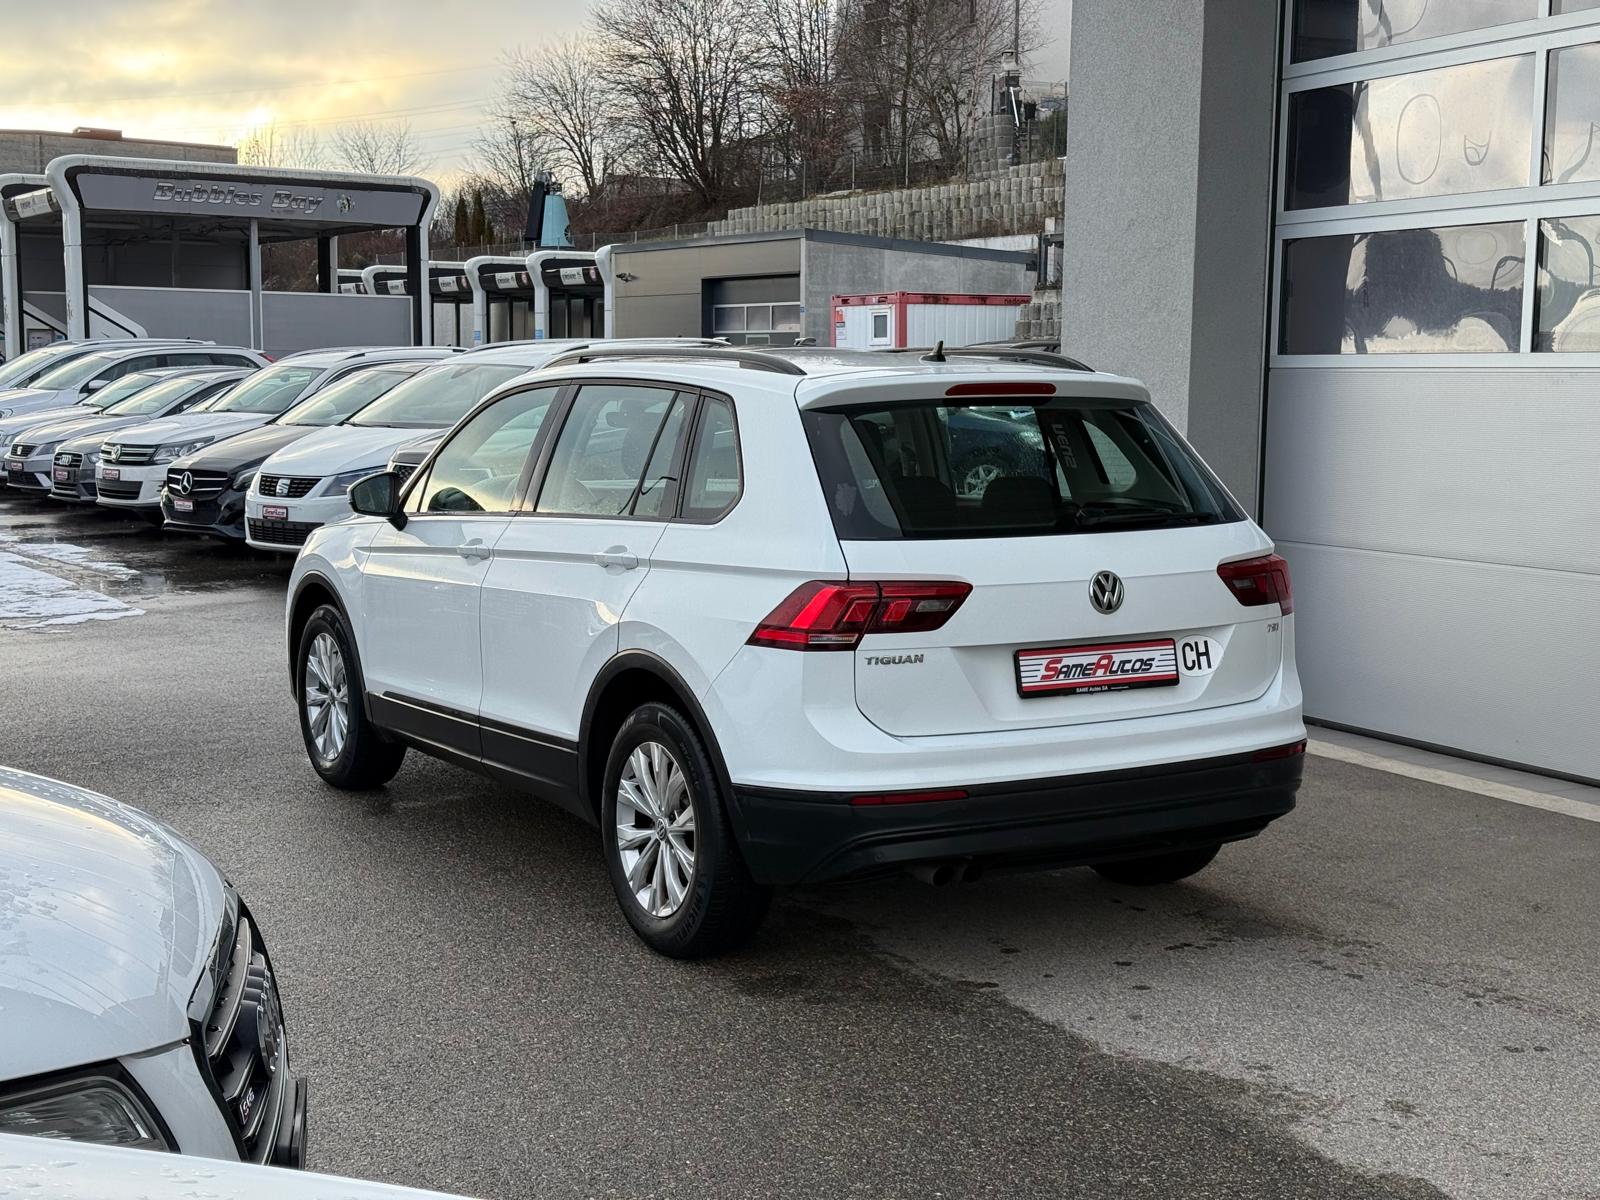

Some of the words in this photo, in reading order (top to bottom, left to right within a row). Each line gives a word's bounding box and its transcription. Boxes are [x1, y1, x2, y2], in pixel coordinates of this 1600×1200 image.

[154, 182, 263, 206] Bubbles
[271, 190, 325, 214] Bay
[864, 653, 924, 665] TIGUAN
[1181, 640, 1212, 671] CH
